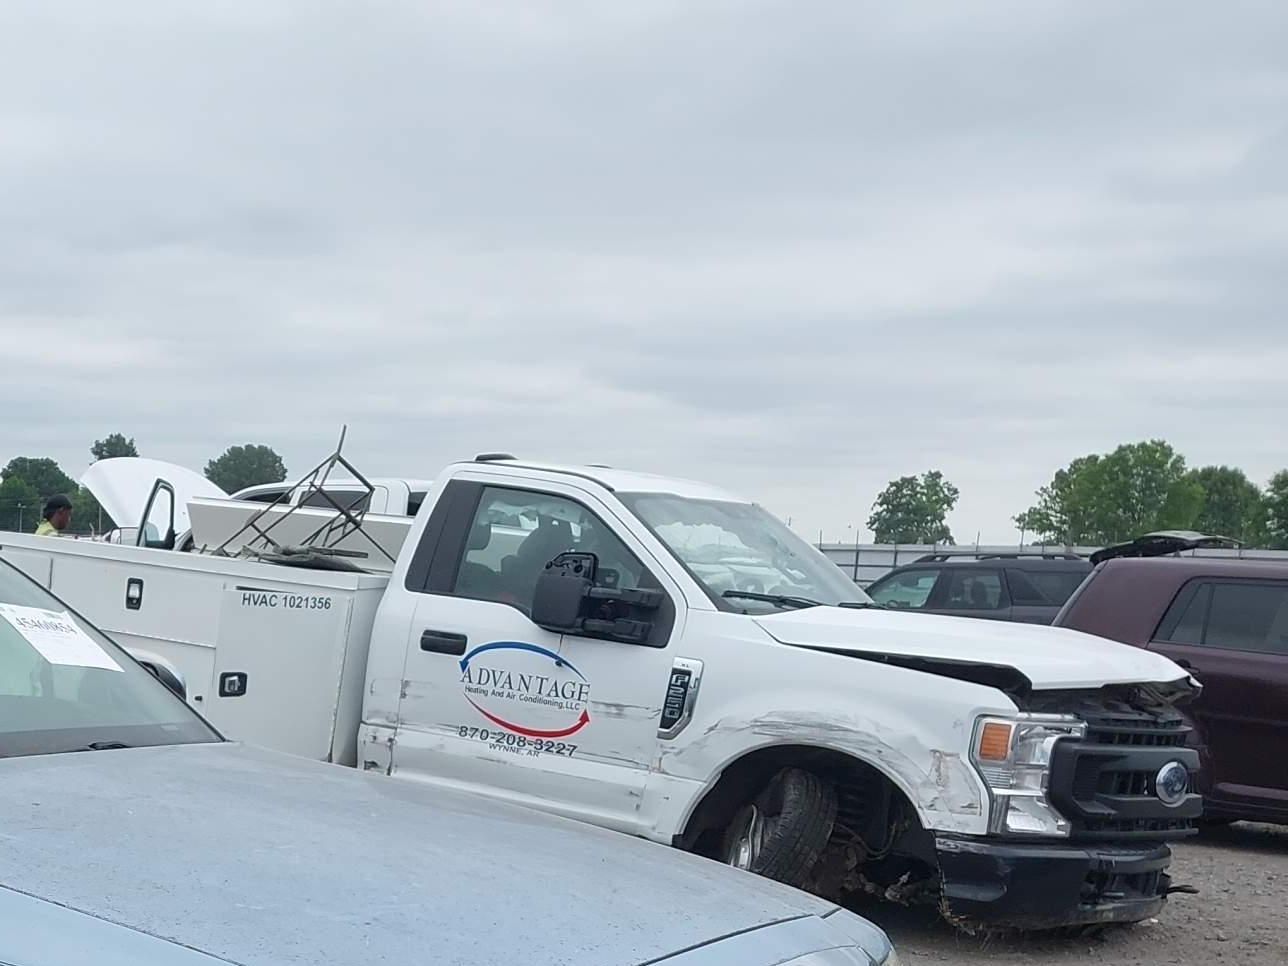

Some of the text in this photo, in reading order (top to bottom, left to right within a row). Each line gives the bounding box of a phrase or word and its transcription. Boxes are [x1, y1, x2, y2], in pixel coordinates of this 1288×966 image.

[242, 593, 332, 610] HVAC 1021356
[460, 667, 591, 703] ADVANTAGE
[465, 686, 489, 697] Heating
[491, 689, 504, 698] And
[505, 690, 516, 700] Air
[458, 725, 578, 757] 870-208-3227
[527, 748, 540, 758] AR
